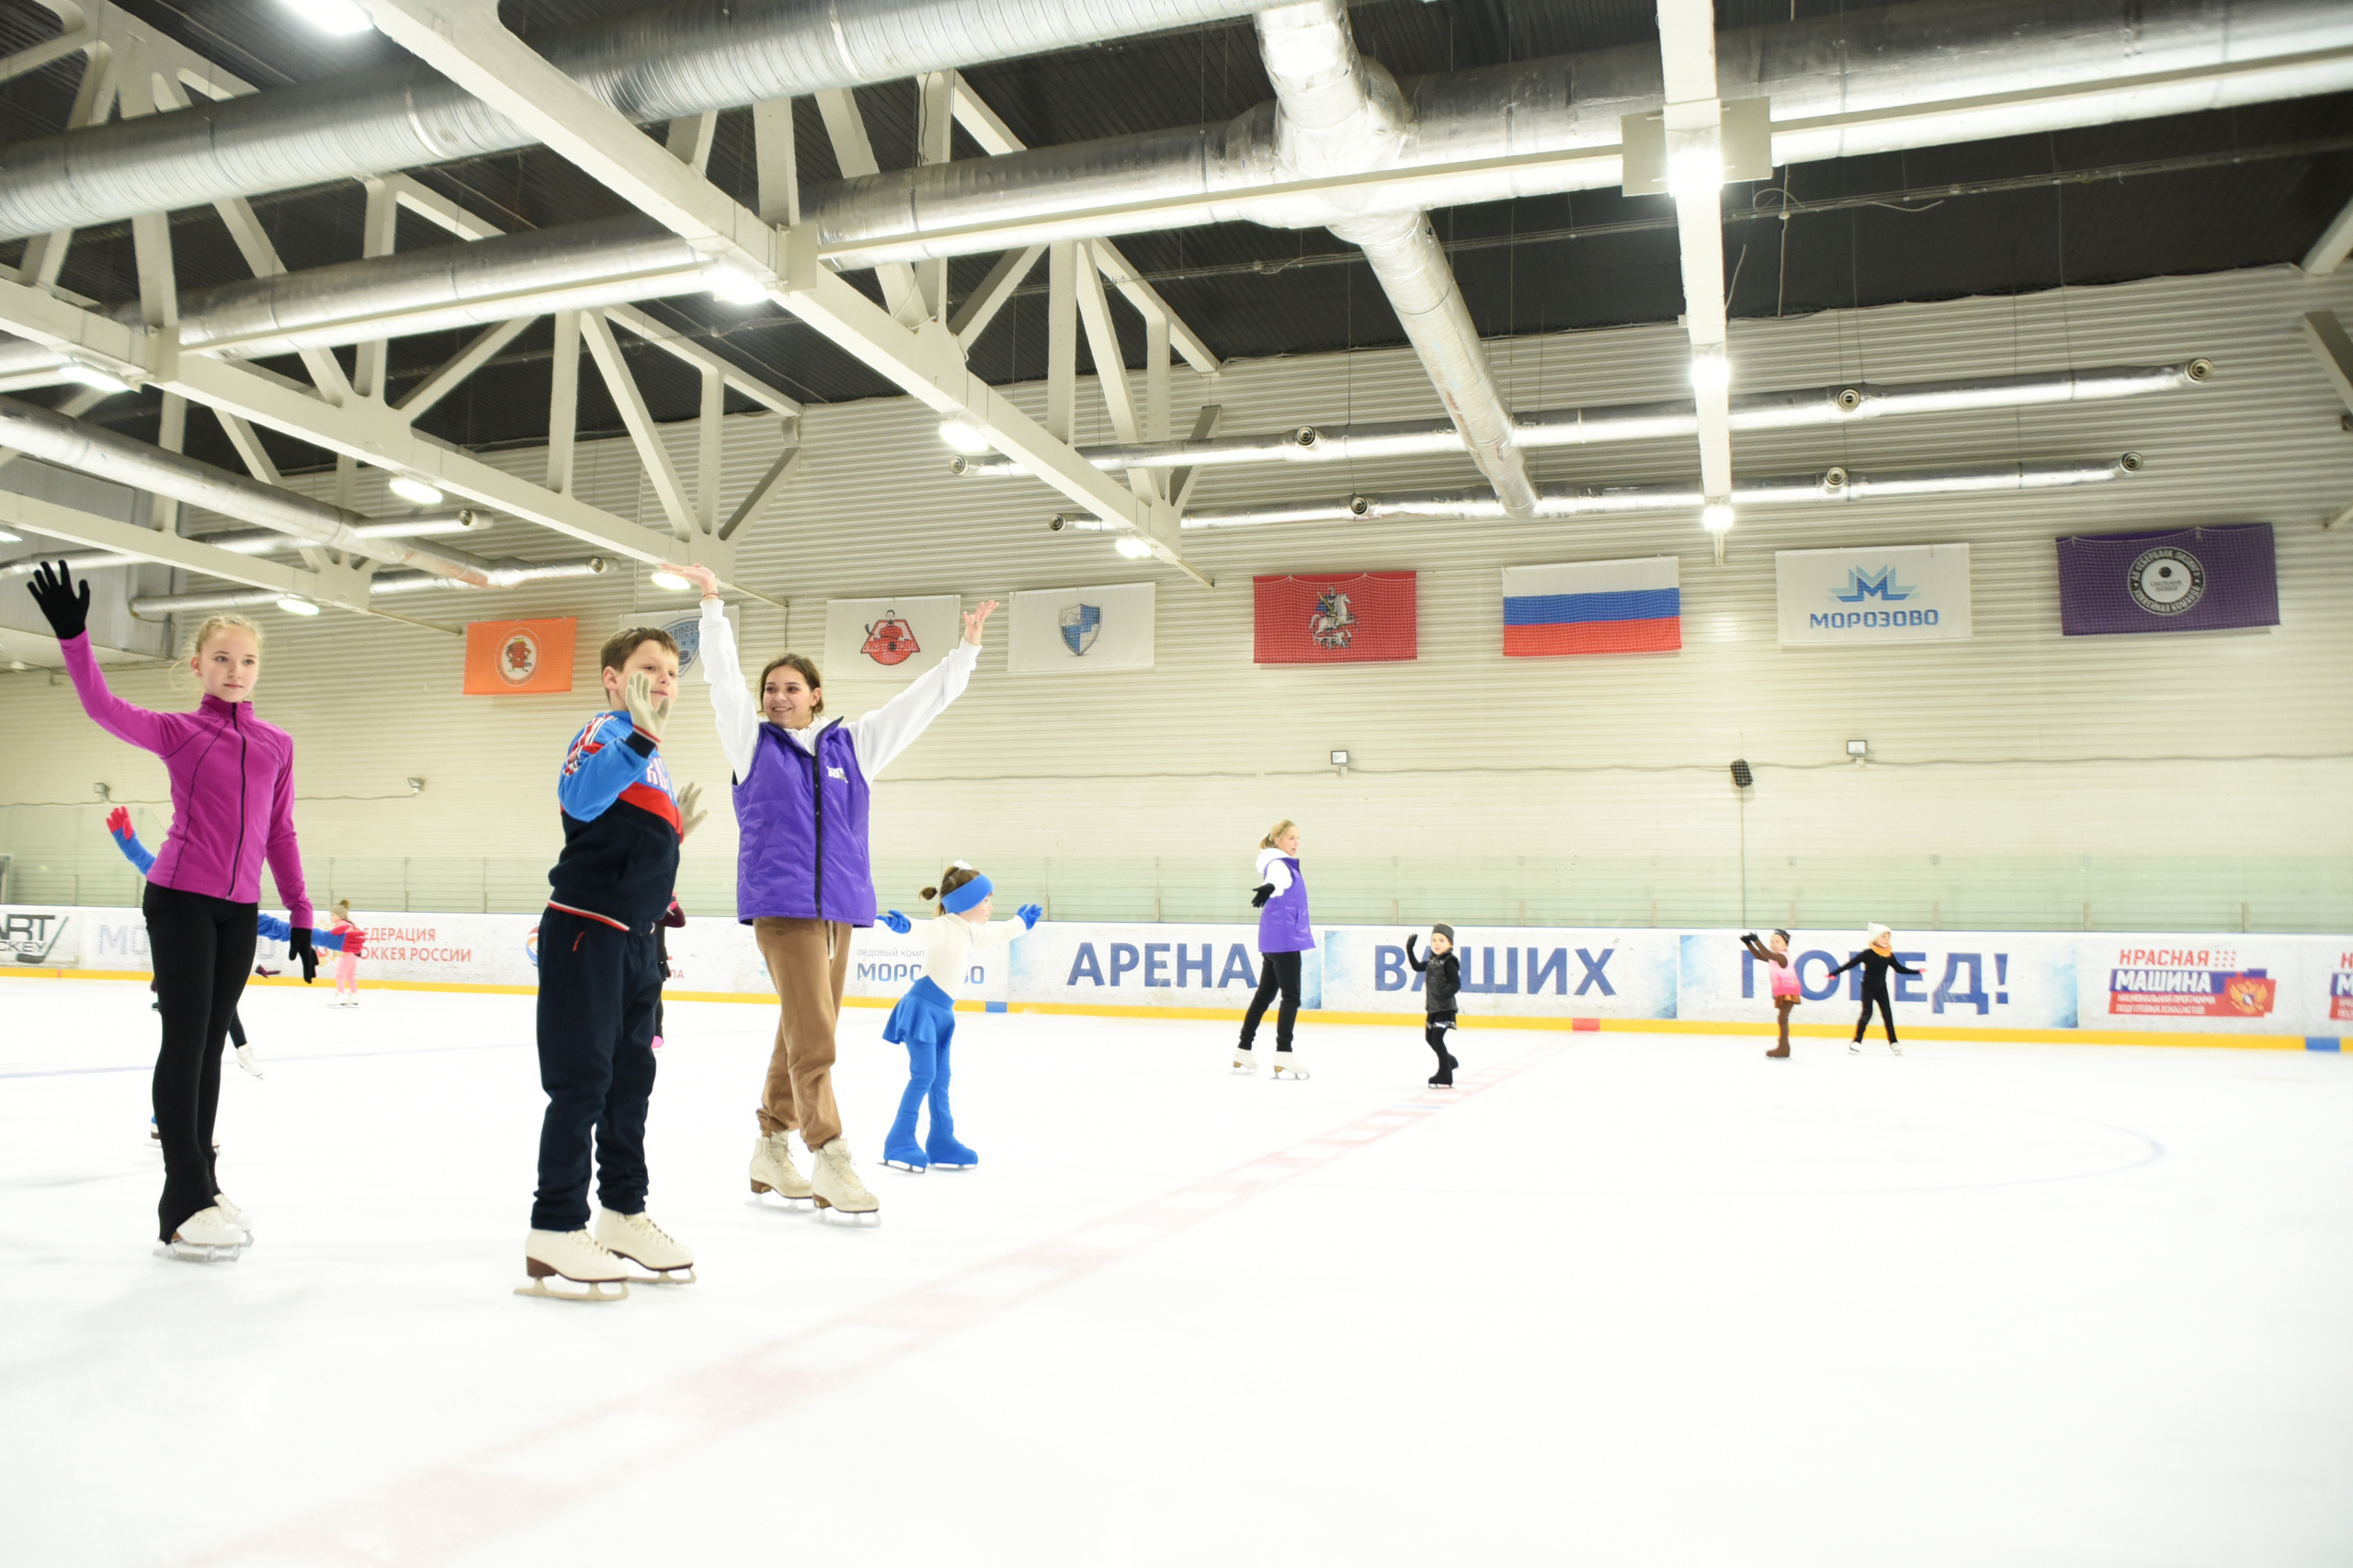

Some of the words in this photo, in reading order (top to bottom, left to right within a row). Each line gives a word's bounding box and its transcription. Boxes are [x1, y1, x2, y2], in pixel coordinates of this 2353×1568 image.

[1810, 609, 1938, 629] МОРОЗОВО
[363, 927, 436, 943] ЕДЕРАЦИЯ
[0, 941, 47, 952] CKEY
[360, 947, 405, 960] ОККЕЯ
[410, 948, 472, 962] РОССИИ
[857, 949, 899, 958] ледовый
[901, 949, 925, 958] комп
[1066, 942, 1258, 989] АРЕНА
[2119, 949, 2210, 967] КРАСНАЯ
[2115, 970, 2212, 994] МАШИНА
